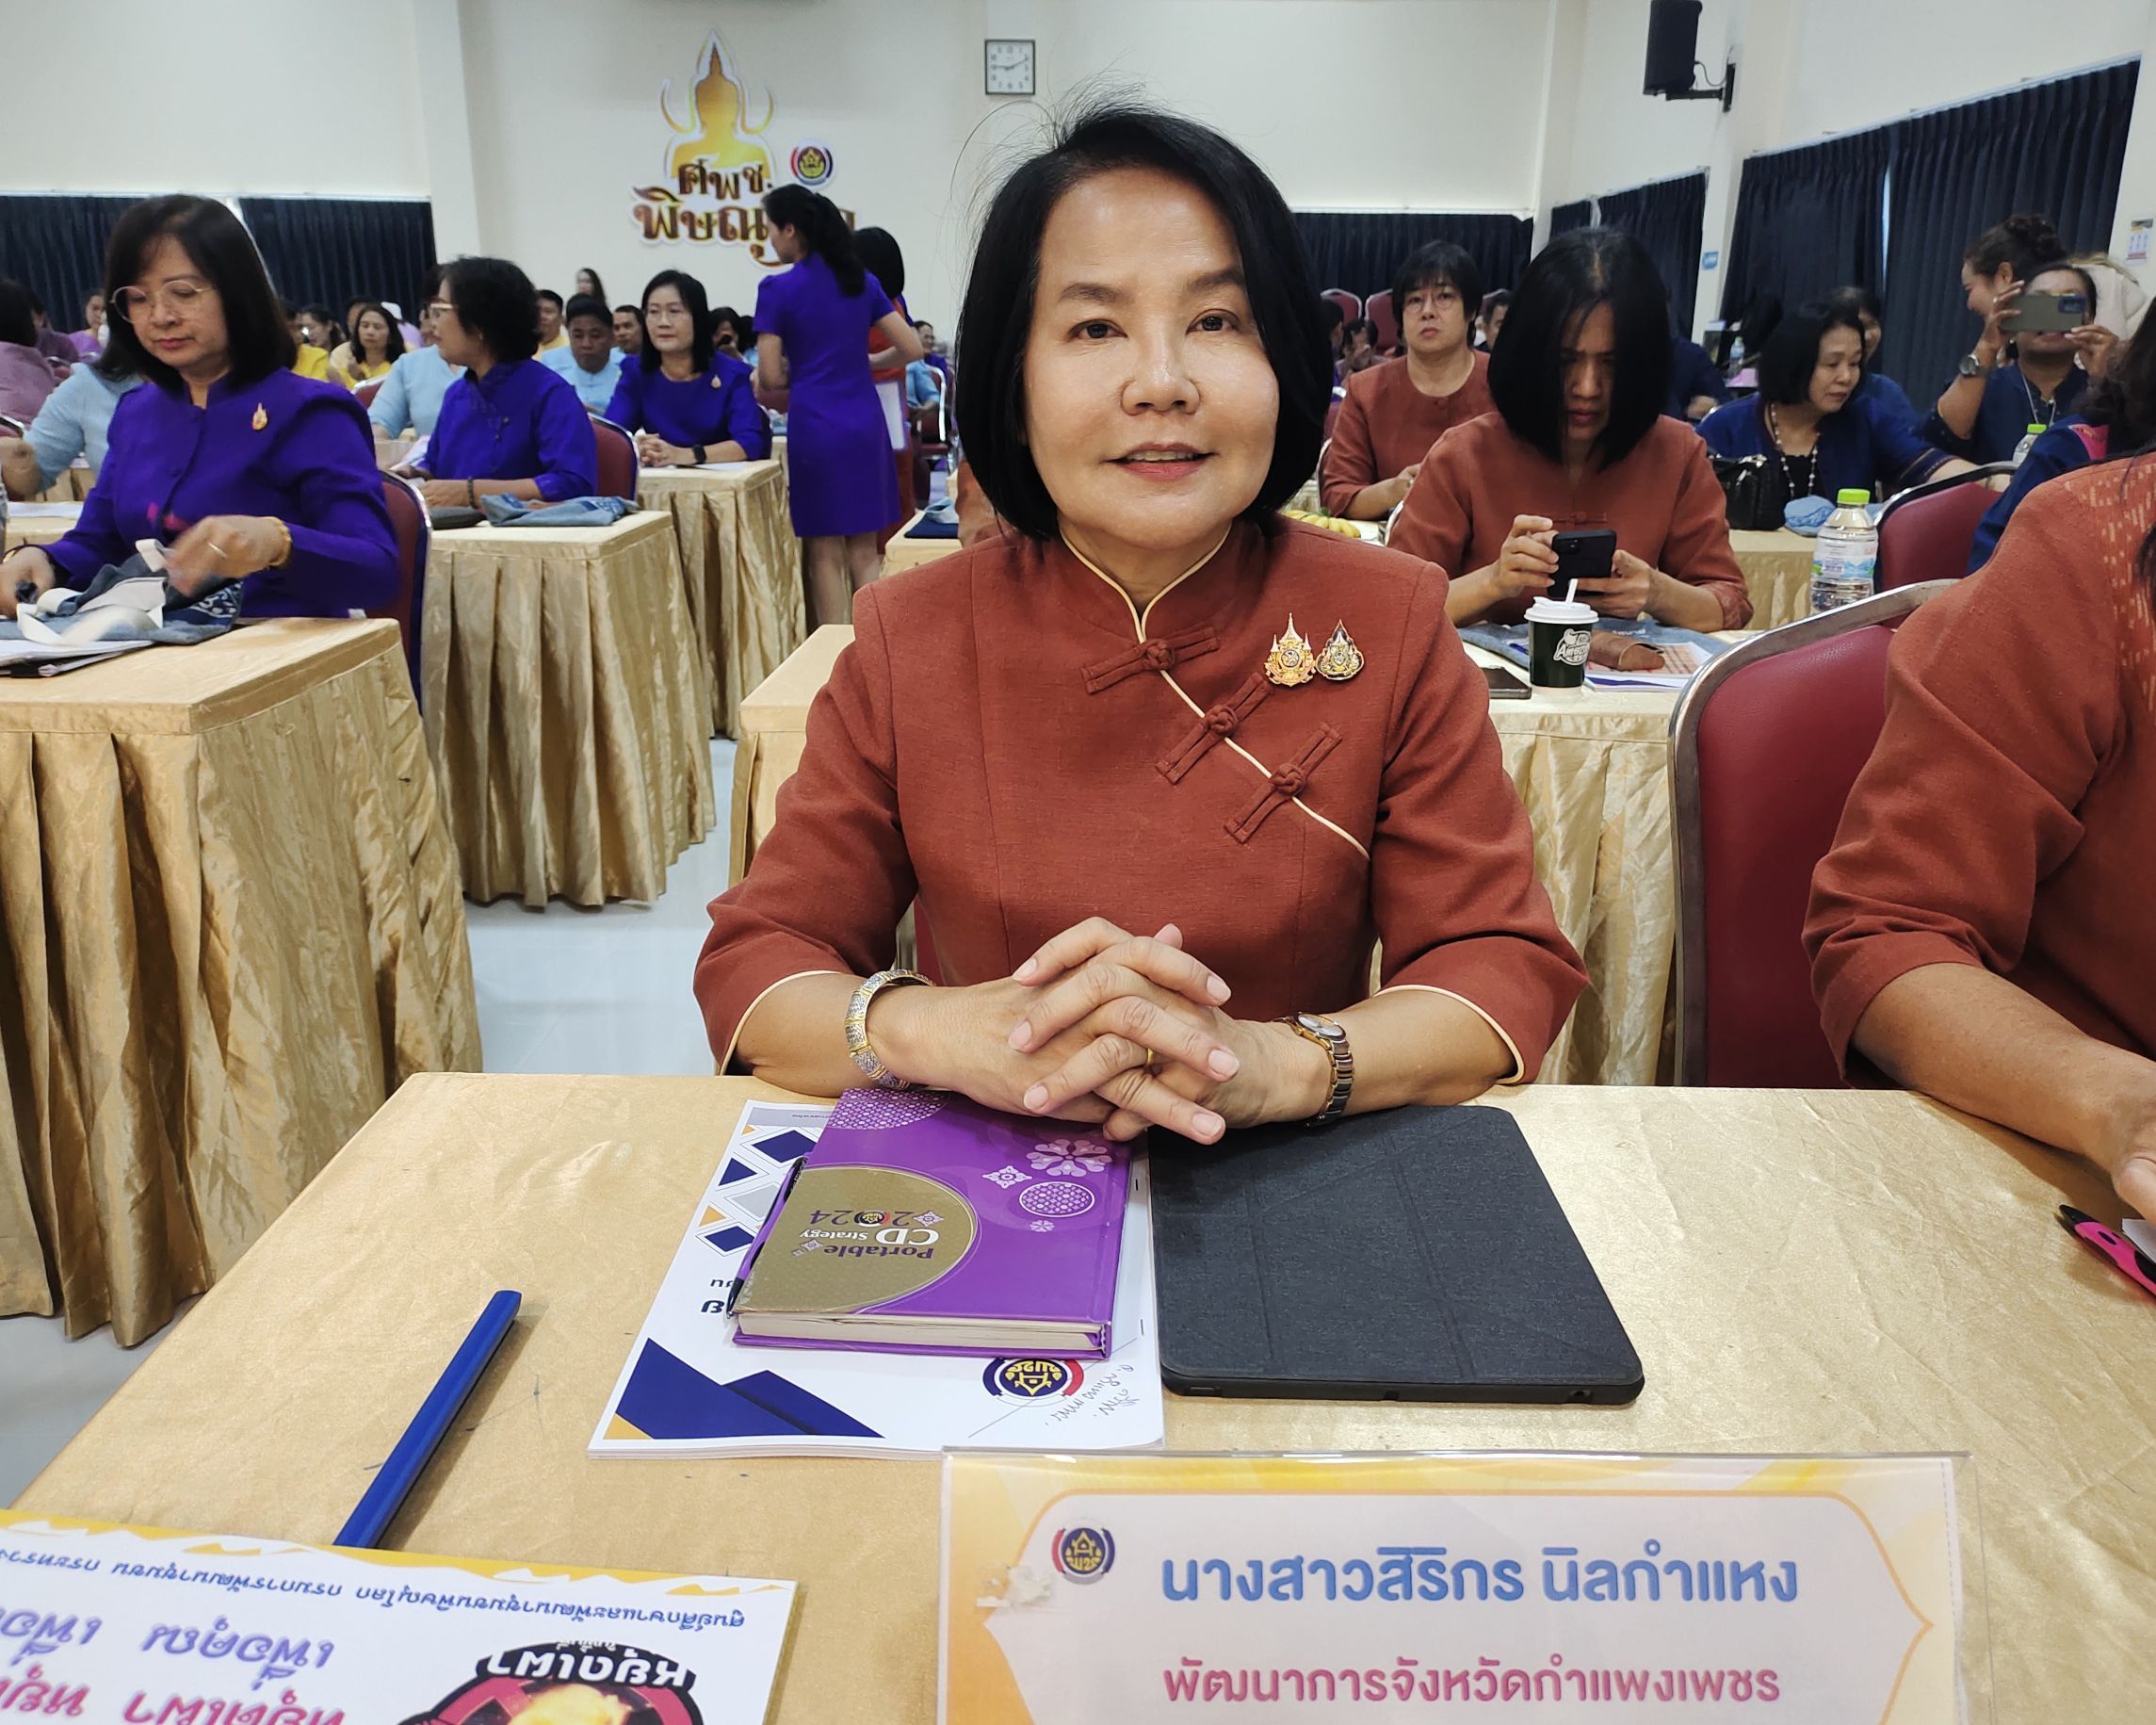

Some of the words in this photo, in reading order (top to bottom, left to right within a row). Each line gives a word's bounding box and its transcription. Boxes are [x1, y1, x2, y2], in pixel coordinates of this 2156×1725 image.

[633, 186, 856, 267] พิษณุ
[799, 1229, 868, 1241] Strategy
[823, 1245, 934, 1260] Portable
[875, 1228, 940, 1245] CD
[110, 1562, 343, 1599] กรมการพัฒนาชุมชน
[1160, 1545, 1526, 1603] นางสาวสิริกร
[1543, 1539, 1799, 1603] นิลกำแหง
[355, 1585, 746, 1632] ศูนย์ศึกษาและพัฒนาชุมชนพิษณุโลก
[0, 1606, 104, 1668] เพื่อ
[140, 1616, 335, 1693] เพื่อคุณ
[0, 1664, 90, 1718] หยุ
[485, 1647, 687, 1692] หยุดเผา
[1163, 1652, 1781, 1703] พัฒนาการจังหวัดกำแพงเพชร
